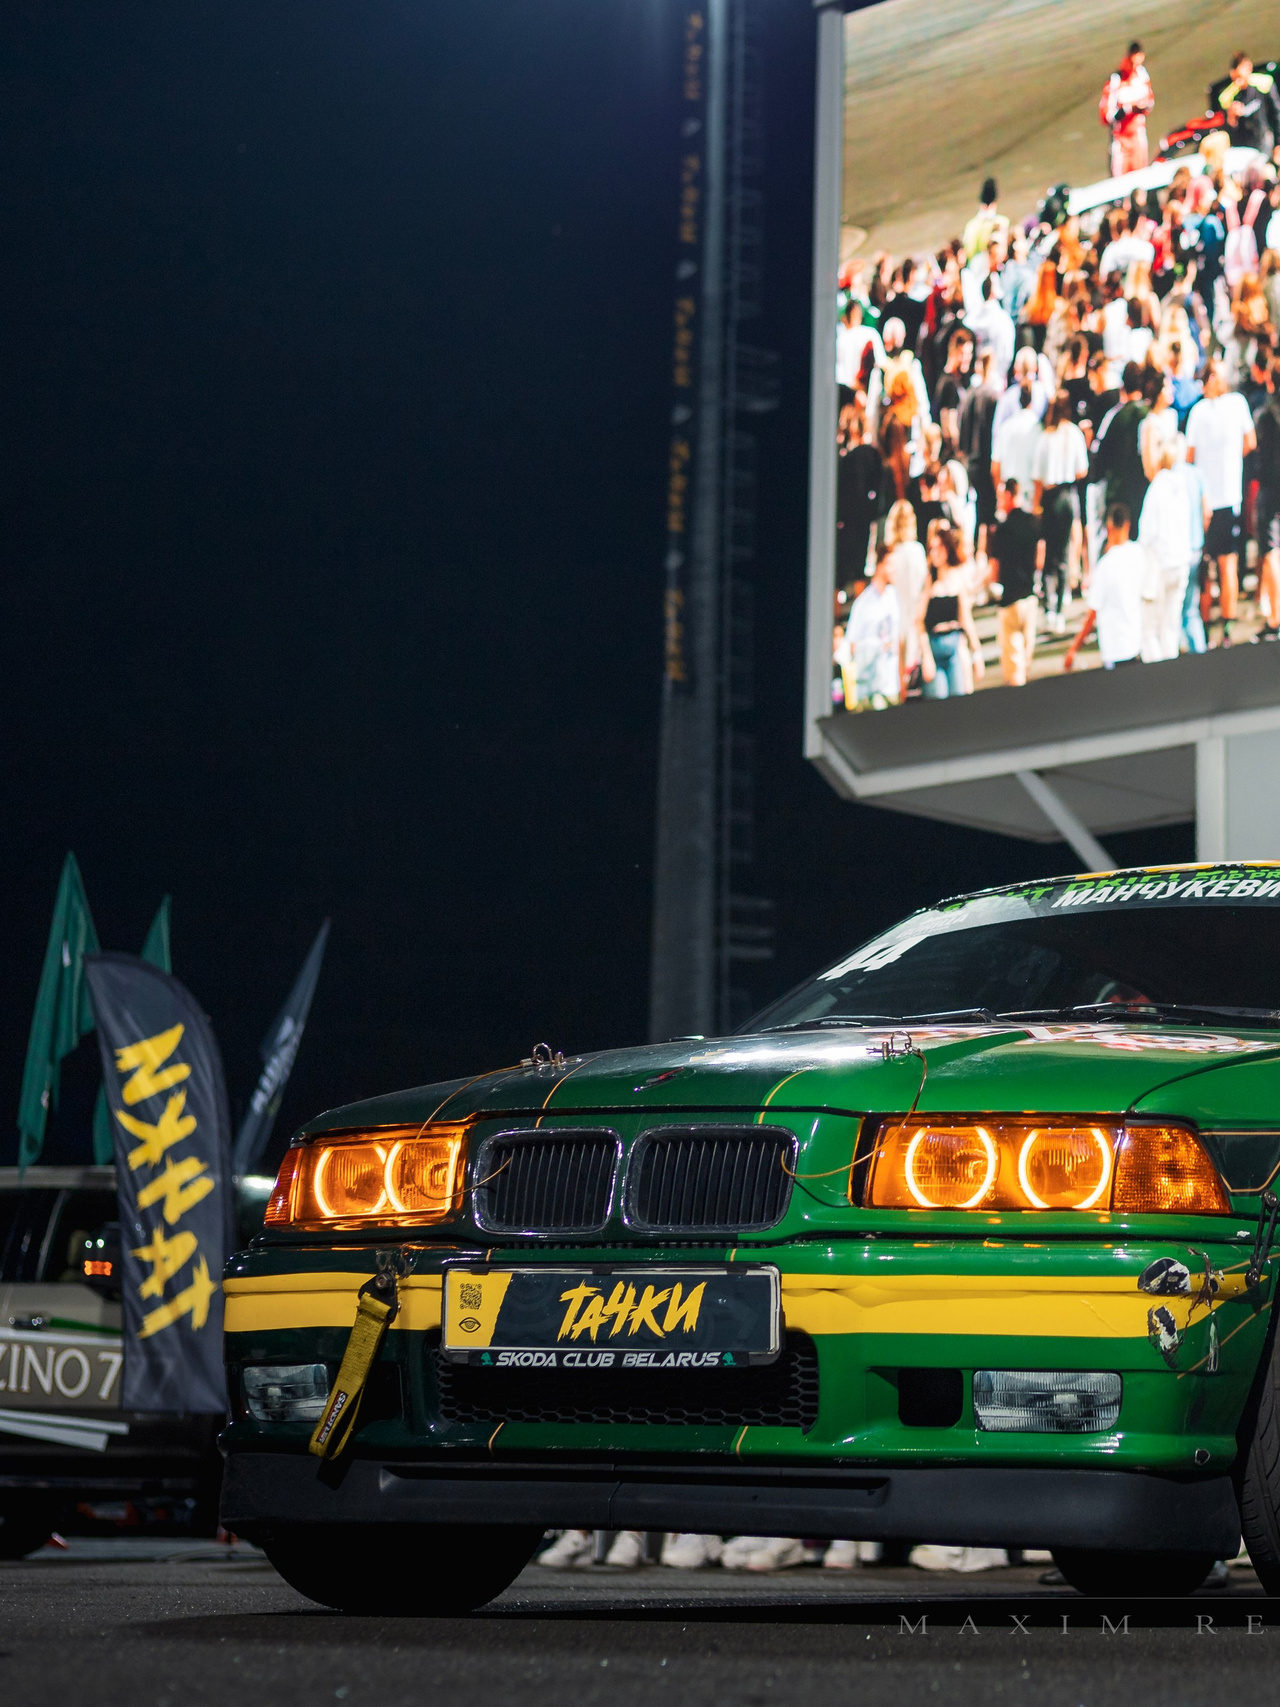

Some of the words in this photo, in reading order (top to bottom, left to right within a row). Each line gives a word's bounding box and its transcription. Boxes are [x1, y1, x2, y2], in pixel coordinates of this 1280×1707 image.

[496, 1352, 557, 1367] SKODA
[562, 1352, 615, 1367] CLUB
[622, 1352, 722, 1367] BELARUS
